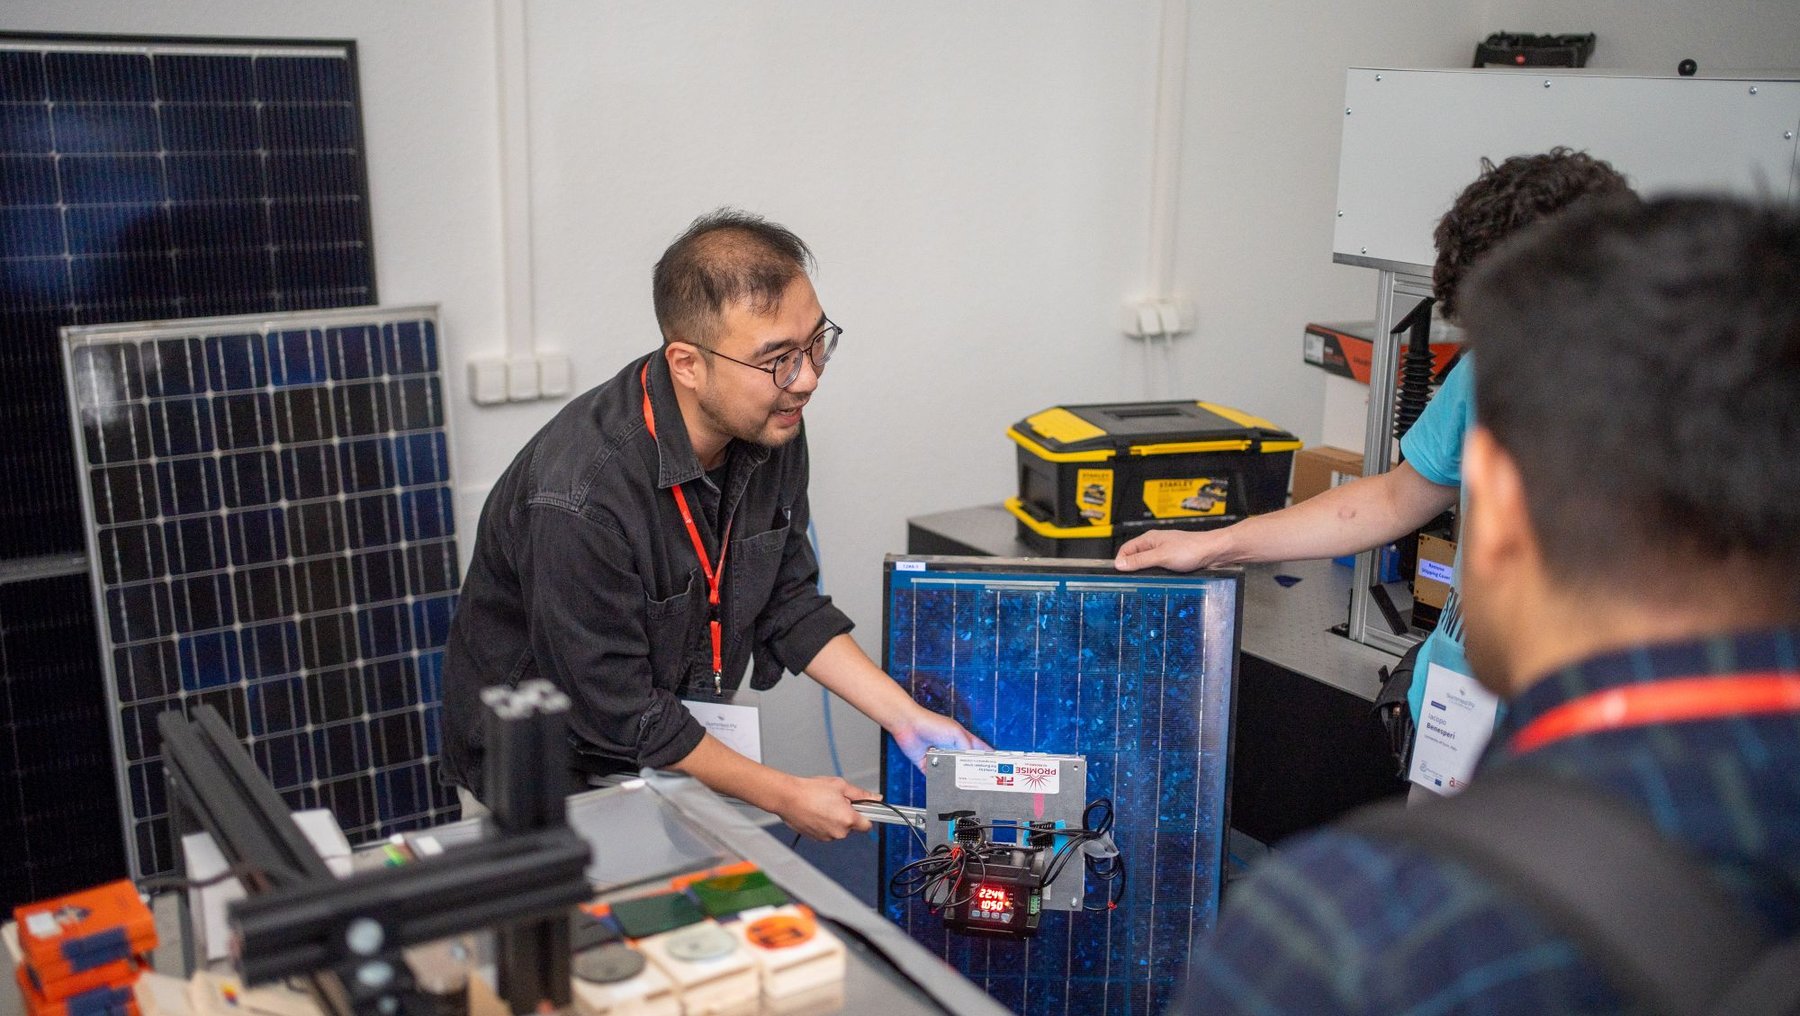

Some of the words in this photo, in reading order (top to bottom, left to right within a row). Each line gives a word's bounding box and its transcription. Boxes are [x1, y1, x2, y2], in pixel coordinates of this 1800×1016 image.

[1159, 479, 1194, 488] STANLEY
[1426, 722, 1457, 740] Benesperi
[1015, 767, 1057, 776] PROMISE
